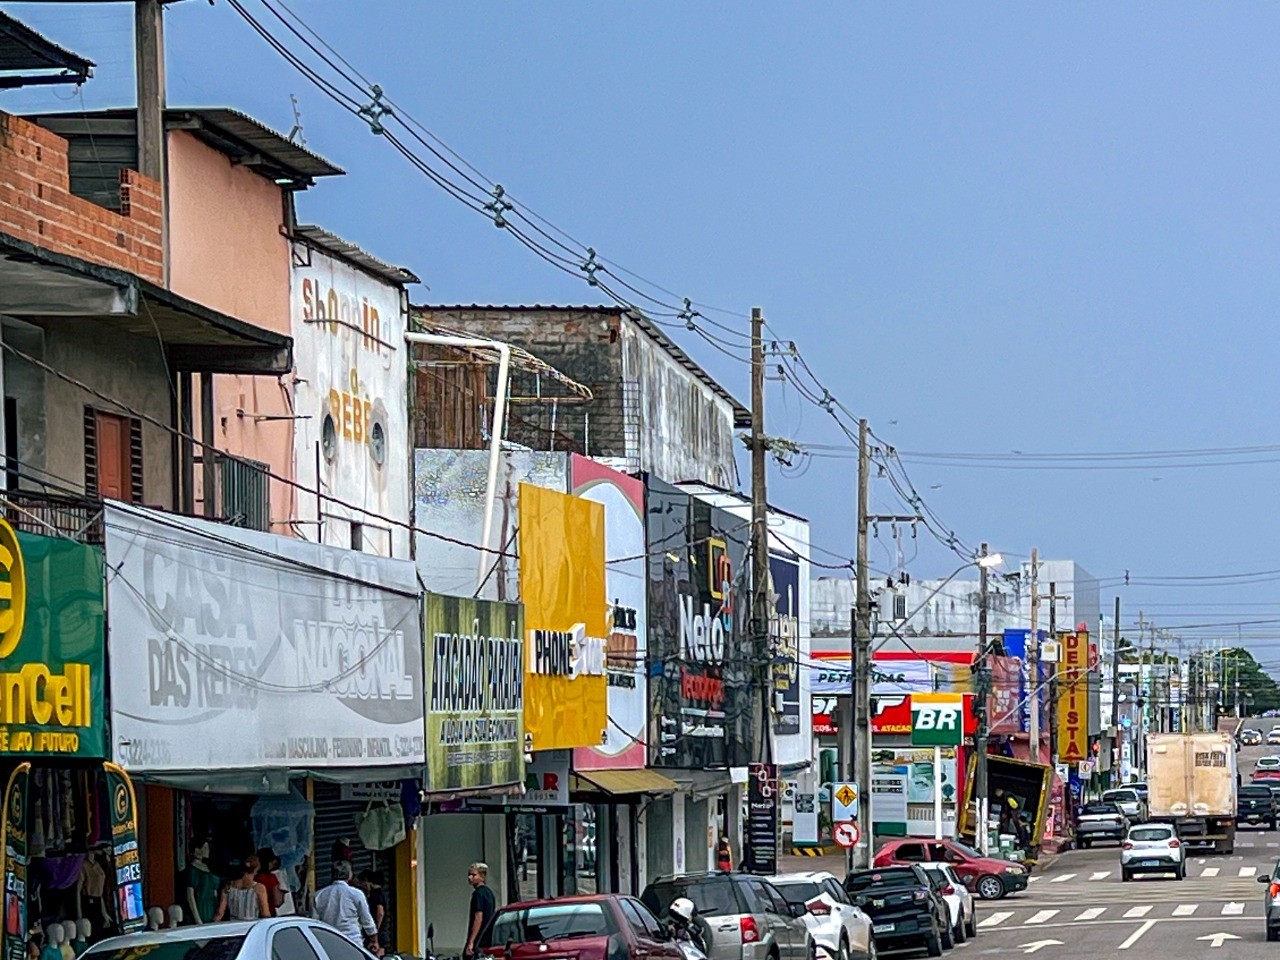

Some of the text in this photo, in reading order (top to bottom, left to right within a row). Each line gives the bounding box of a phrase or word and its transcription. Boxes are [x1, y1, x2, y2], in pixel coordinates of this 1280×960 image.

[142, 544, 256, 640] CASA
[325, 549, 384, 626] LOJA
[294, 619, 413, 701] NACIONAL
[678, 592, 725, 662] Neto
[147, 639, 259, 711] DAS REDES
[1066, 634, 1080, 756] DENTISTA
[41, 732, 79, 753] FUTURO
[915, 708, 958, 730] BR
